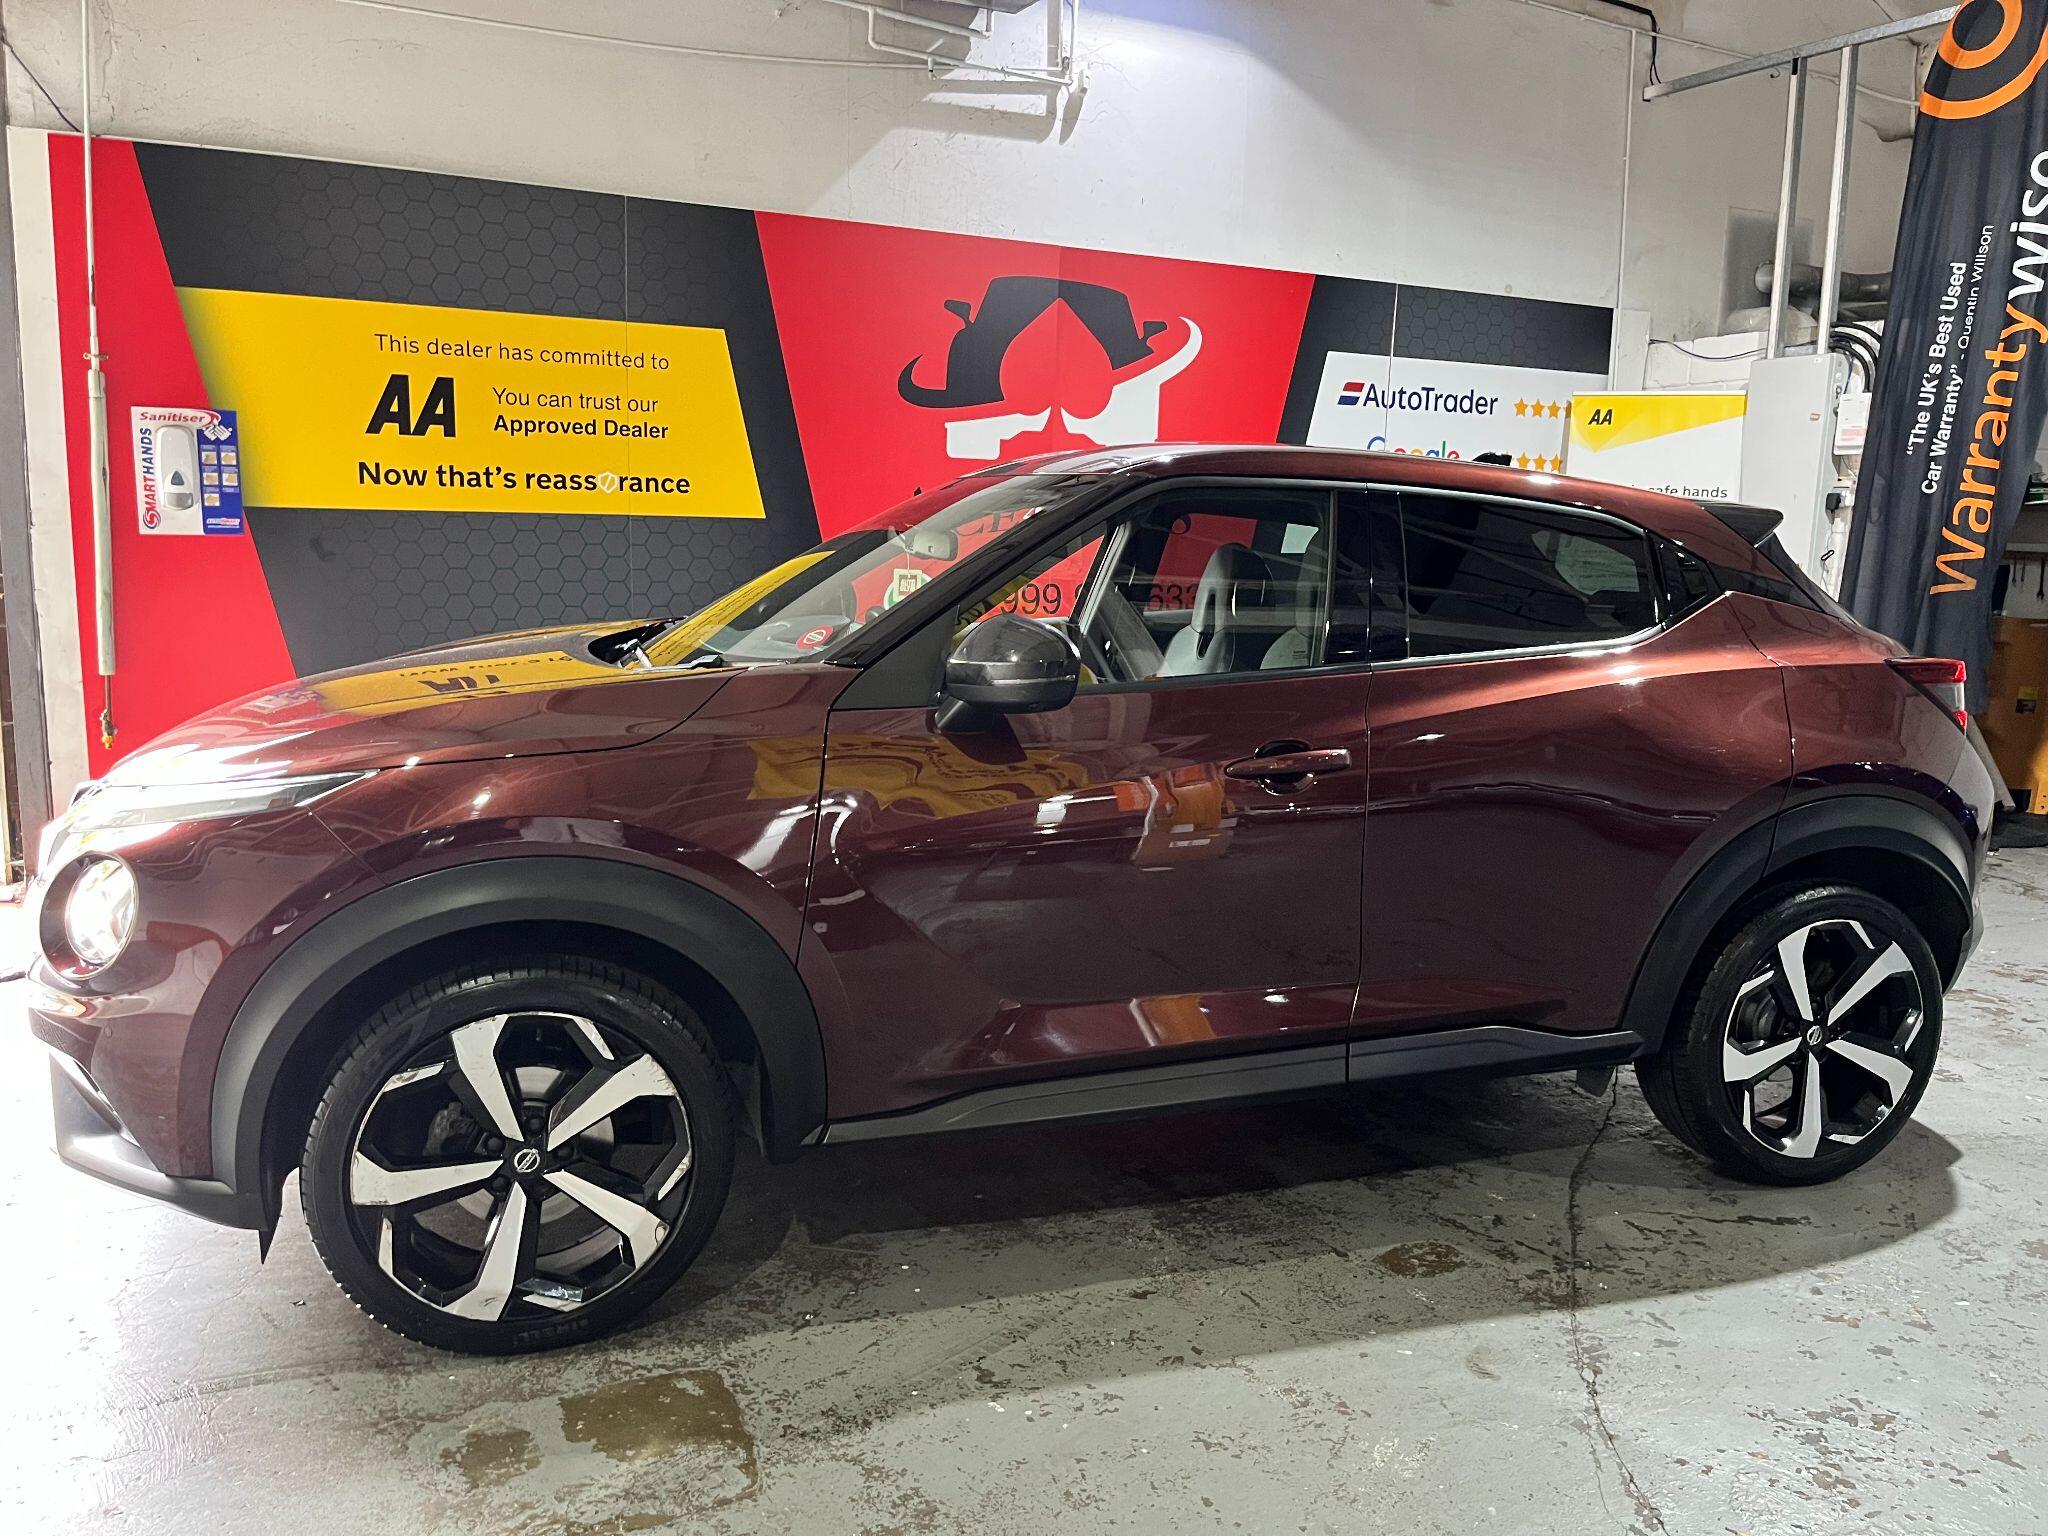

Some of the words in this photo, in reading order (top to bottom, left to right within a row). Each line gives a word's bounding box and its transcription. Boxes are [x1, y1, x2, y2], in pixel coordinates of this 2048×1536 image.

[1940, 262, 1967, 310] Used
[374, 333, 419, 354] This
[427, 338, 492, 359] dealer
[499, 343, 533, 361] has
[540, 348, 644, 369] committed
[651, 353, 669, 370] to
[1929, 315, 1955, 358] Best
[1921, 461, 1942, 494] Car
[1958, 287, 1979, 349] Quentin
[1971, 225, 1994, 282] Willson
[365, 373, 457, 438] AA
[492, 387, 530, 406] You
[537, 391, 572, 408] can
[578, 393, 622, 411] trust
[627, 397, 659, 413] our
[1363, 383, 1499, 415] AutoTrader
[140, 411, 206, 423] Sanitiser
[493, 415, 597, 437] Approved
[604, 420, 669, 439] Dealer
[1588, 409, 1613, 425] AA
[358, 461, 428, 487] Now
[436, 464, 517, 489] that’s
[1683, 486, 1728, 498] hands
